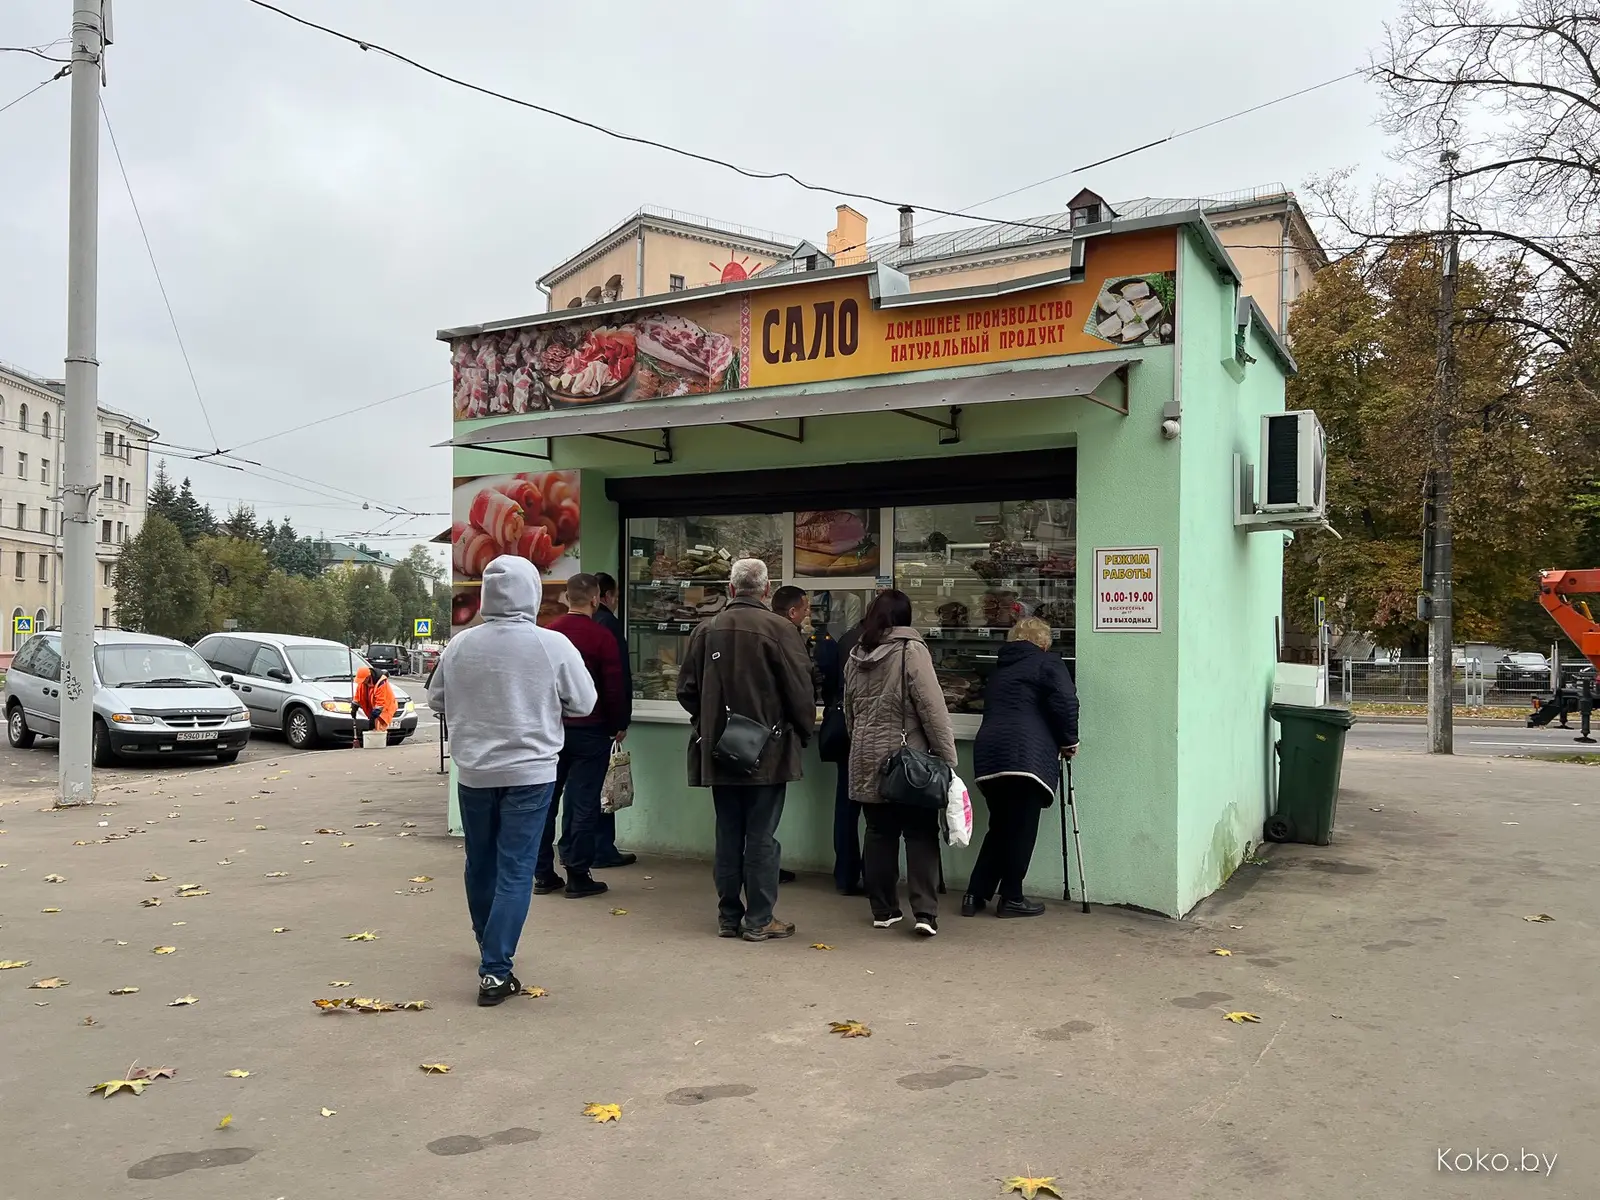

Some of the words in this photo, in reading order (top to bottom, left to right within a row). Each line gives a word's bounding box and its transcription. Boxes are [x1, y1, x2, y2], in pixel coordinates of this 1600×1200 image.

[762, 298, 859, 364] САЛО
[885, 314, 961, 342] ДОМАШНЕЕ
[966, 299, 1073, 331] ПРОИЗВОДСТВО
[890, 331, 990, 363] НАТУРАЛЬНЫЙ
[999, 324, 1065, 350] ПРОДУКТ
[1105, 554, 1150, 565] РЕЖИМ
[1103, 568, 1151, 579] РАБОТЫ
[1101, 592, 1153, 602] 10.00-19.00
